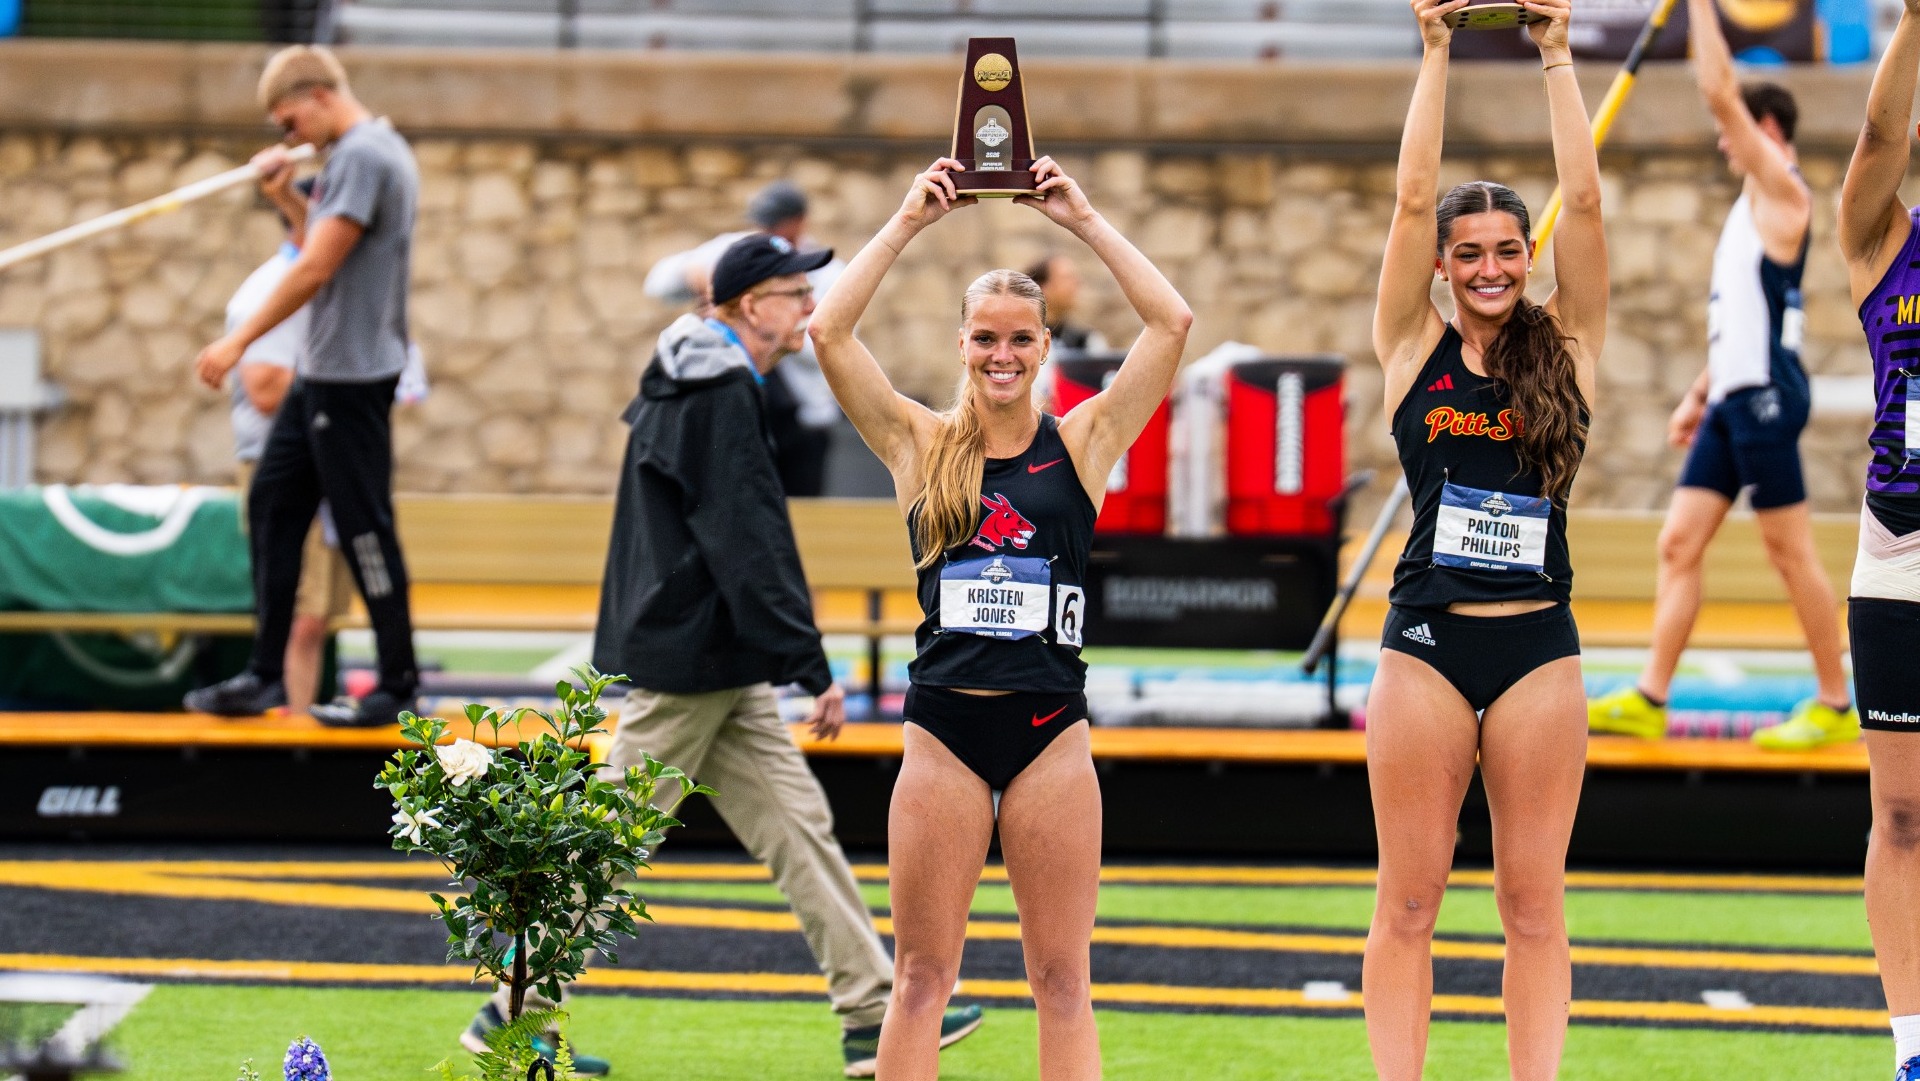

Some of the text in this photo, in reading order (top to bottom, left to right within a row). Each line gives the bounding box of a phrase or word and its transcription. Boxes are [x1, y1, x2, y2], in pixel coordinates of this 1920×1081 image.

[977, 70, 1011, 82] NCAA
[1425, 406, 1490, 443] Pitt
[1467, 518, 1520, 540] PAYTON
[1461, 536, 1521, 559] PHILLIPS
[967, 588, 1024, 606] KRISTEN
[972, 607, 1016, 624] JONES
[1061, 592, 1079, 642] 6
[1402, 629, 1436, 647] adidas
[36, 785, 121, 817] GILL
